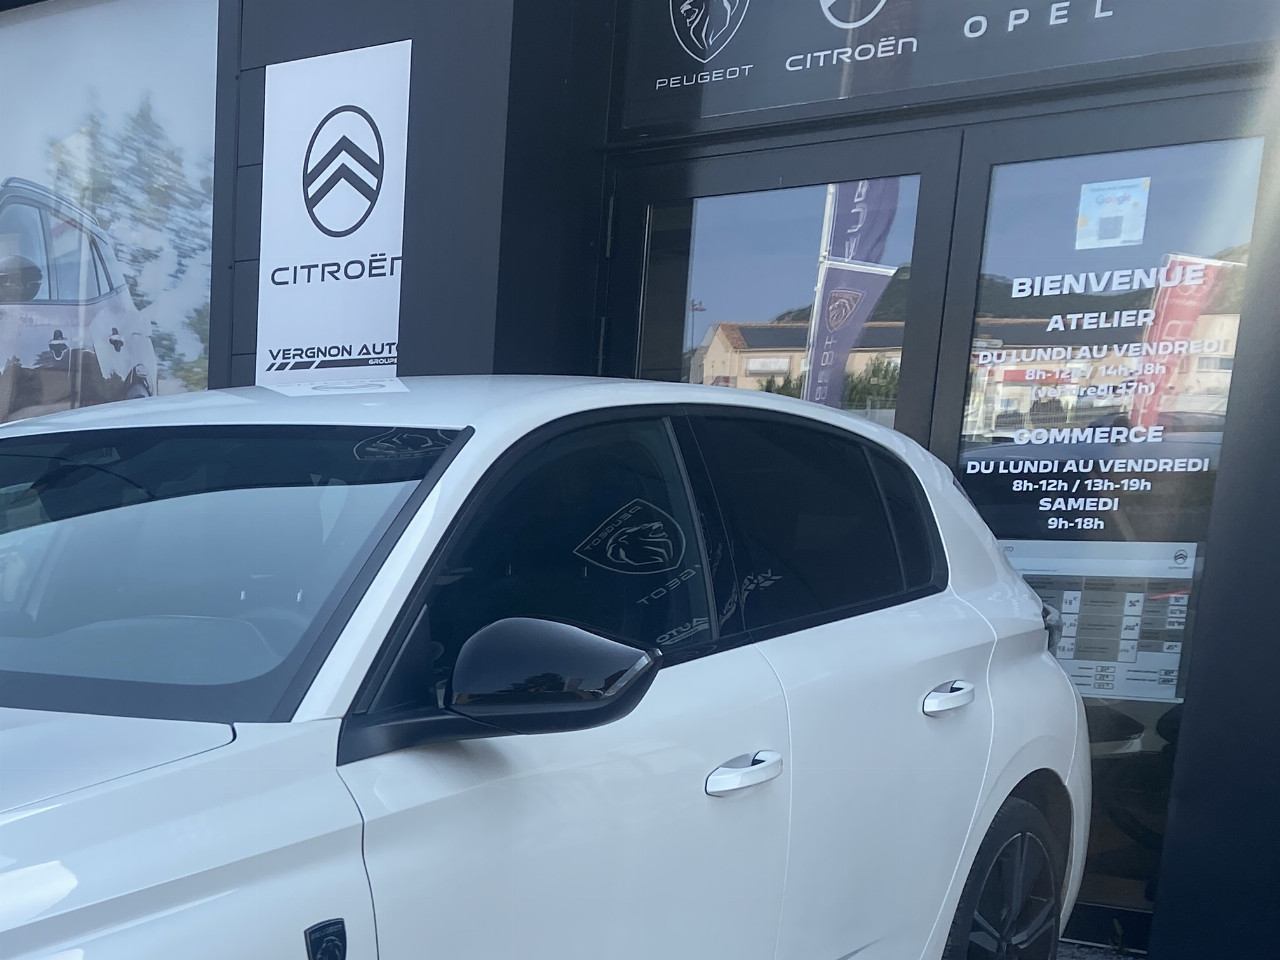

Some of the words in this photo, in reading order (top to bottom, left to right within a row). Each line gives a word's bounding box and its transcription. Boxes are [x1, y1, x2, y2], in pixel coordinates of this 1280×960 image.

[963, 0, 1114, 38] OPEL
[784, 36, 918, 71] CITROËN
[655, 64, 754, 90] PEUGEOT
[1011, 264, 1206, 299] BIENVENUE
[1046, 309, 1156, 332] ATELIER
[268, 344, 353, 361] VERGNON
[356, 341, 398, 356] AUT
[978, 351, 1007, 365] DU
[1010, 347, 1072, 363] LUNDI
[1076, 344, 1108, 360] AU
[1113, 338, 1222, 358] VENDREDI
[1013, 426, 1165, 445] COMMERCE
[966, 460, 996, 474] DU
[998, 459, 1059, 474] LUNDI
[1063, 459, 1095, 473] AU
[1098, 458, 1210, 473] VENDREDI
[1012, 480, 1069, 492] 8h-12h
[1084, 478, 1152, 491] 13h-19h
[1038, 497, 1120, 511] SAMEDI
[1047, 517, 1106, 530] 9h-18h
